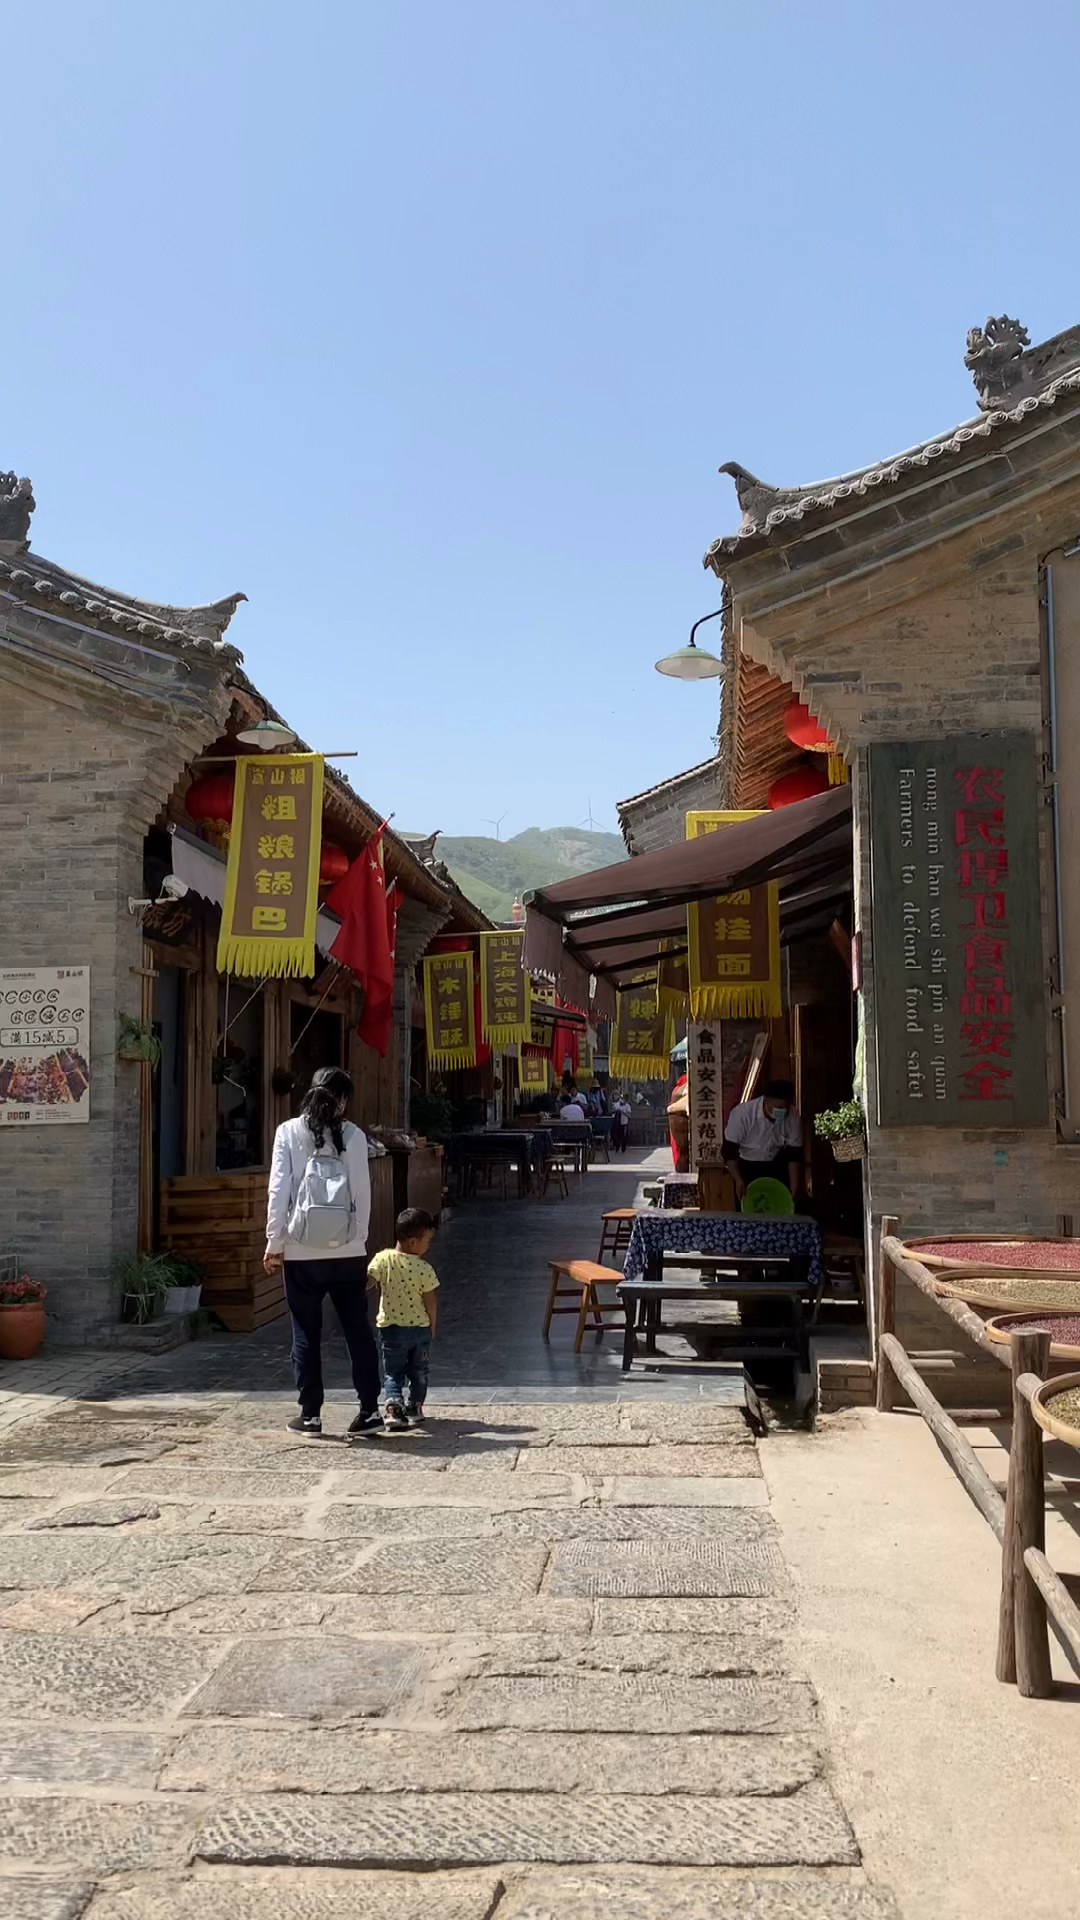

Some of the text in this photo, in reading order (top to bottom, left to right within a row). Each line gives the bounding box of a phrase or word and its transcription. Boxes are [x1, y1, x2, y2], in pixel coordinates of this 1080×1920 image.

[899, 768, 916, 848] Farmers
[252, 793, 297, 932] 粗粮锅巴
[902, 864, 917, 885] to
[902, 901, 922, 971] defend
[921, 767, 948, 1101] nong min han wei shi pin an quan
[953, 766, 1015, 1102] 农民捍卫食品安全
[904, 987, 924, 1033] food
